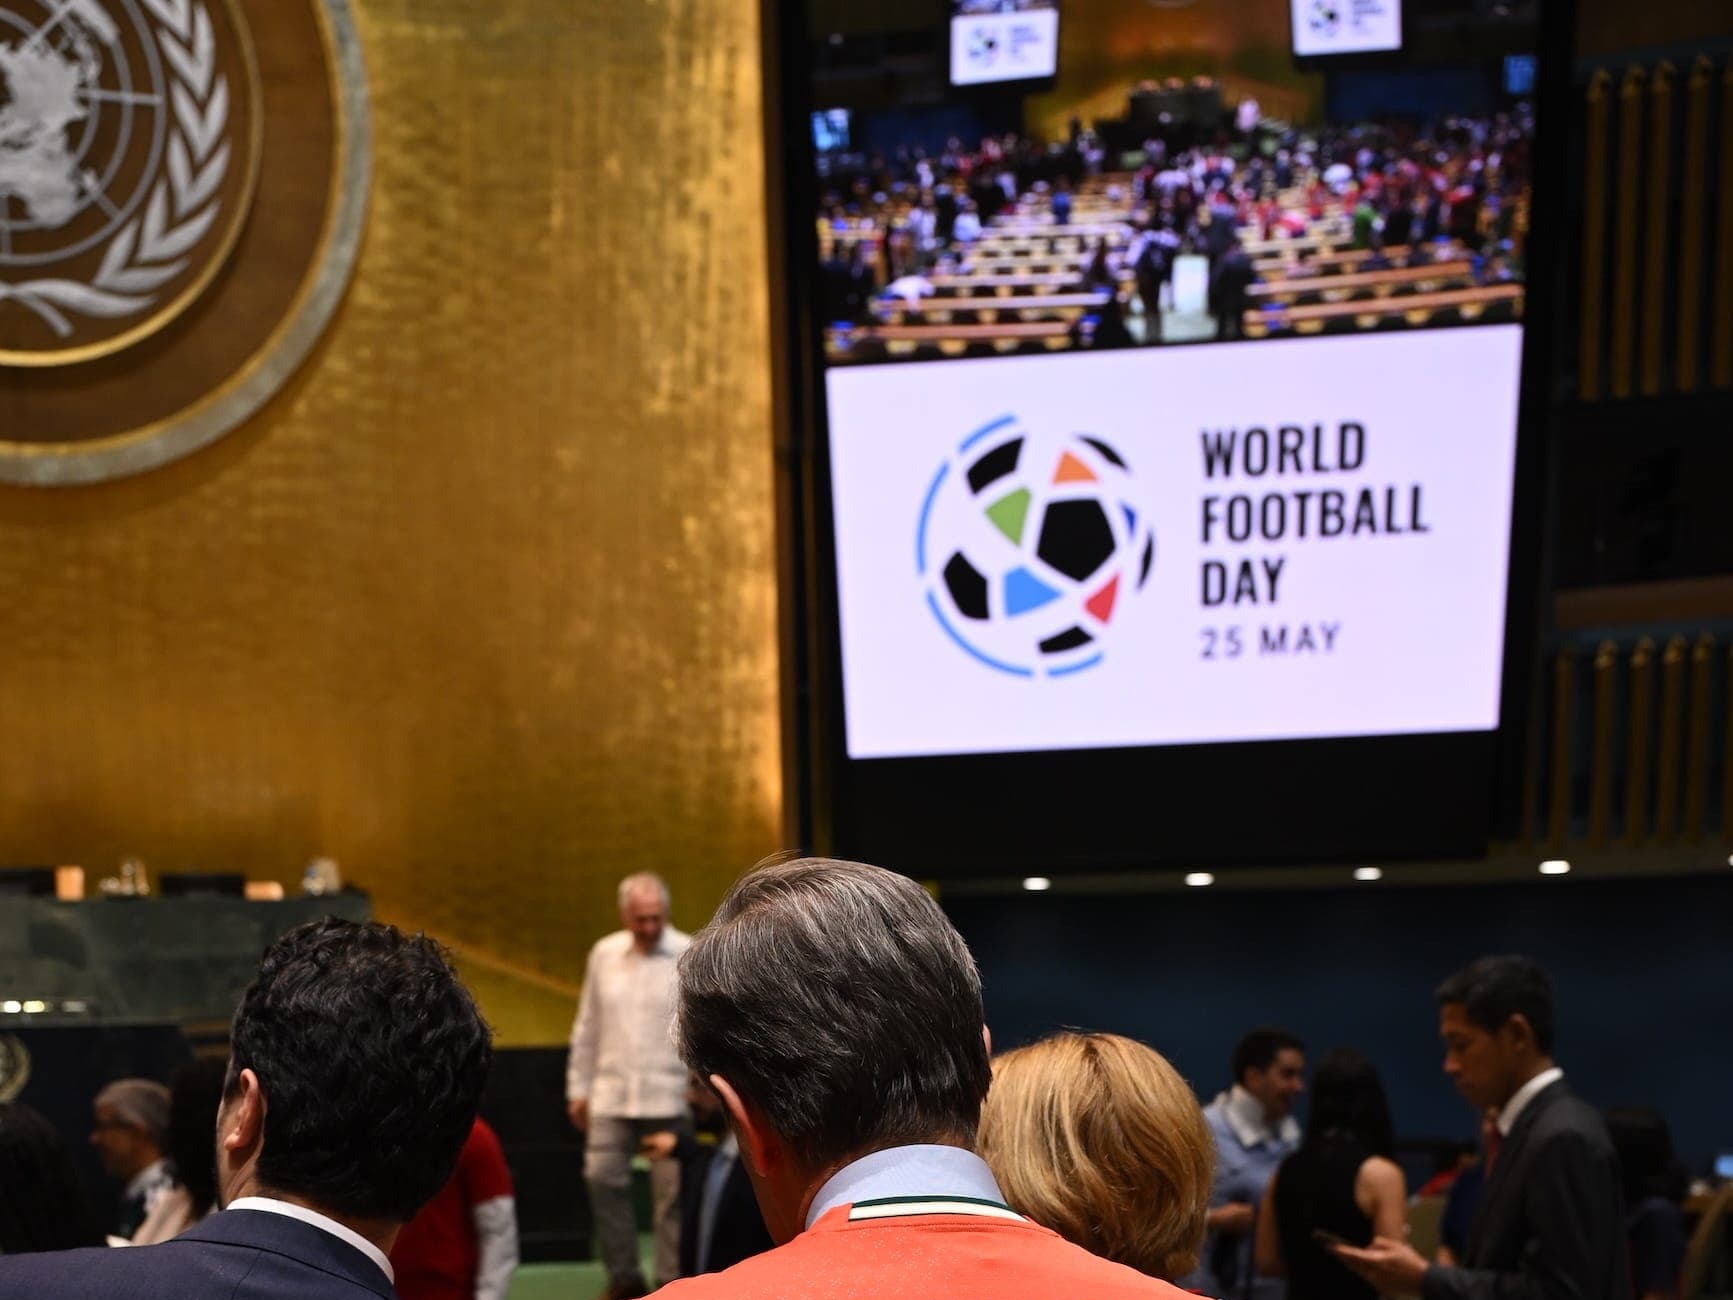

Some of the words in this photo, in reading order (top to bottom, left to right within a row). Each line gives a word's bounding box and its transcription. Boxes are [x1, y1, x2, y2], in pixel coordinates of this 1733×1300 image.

[1201, 422, 1365, 479] WORLD
[1201, 484, 1430, 543] FOOTBALL
[1201, 557, 1284, 606] DAY
[1200, 626, 1242, 659] 25
[1260, 621, 1340, 653] MAY
